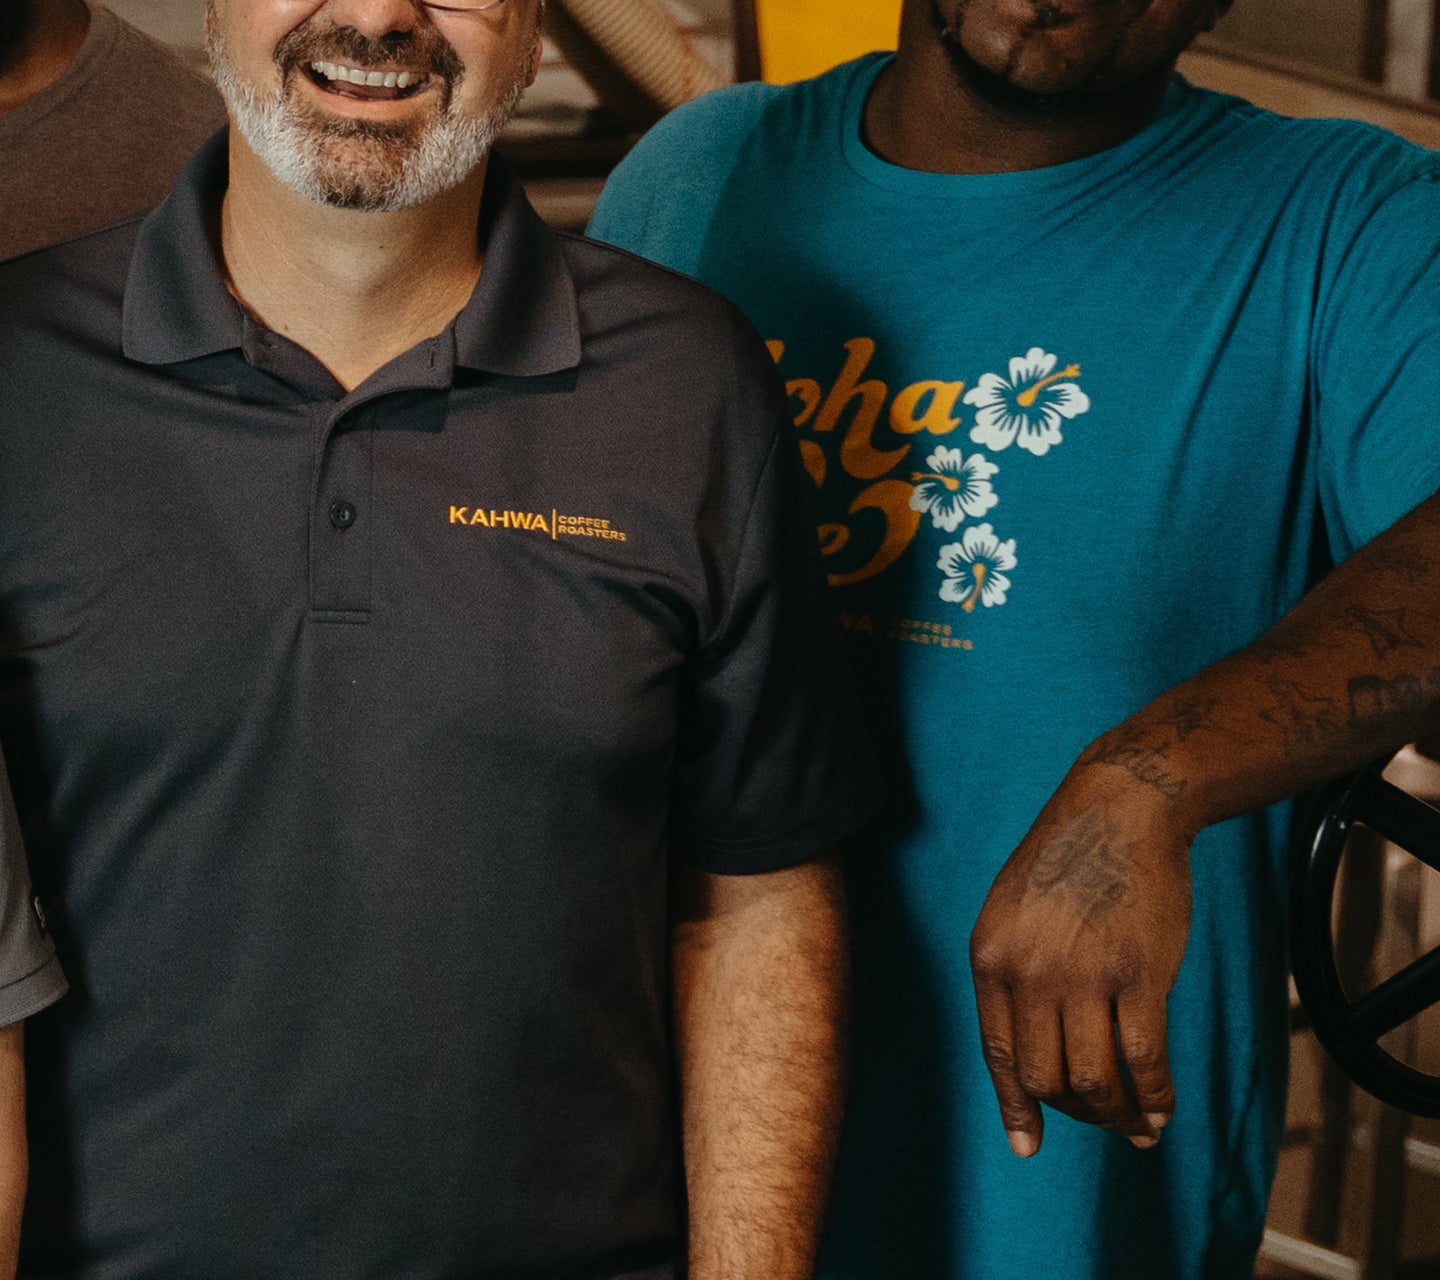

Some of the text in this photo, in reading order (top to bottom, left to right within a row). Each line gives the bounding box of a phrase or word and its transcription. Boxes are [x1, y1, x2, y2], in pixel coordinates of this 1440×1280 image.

[449, 505, 550, 532] KAHWA
[558, 515, 610, 529] COFFEE
[558, 525, 626, 541] ROASTERS
